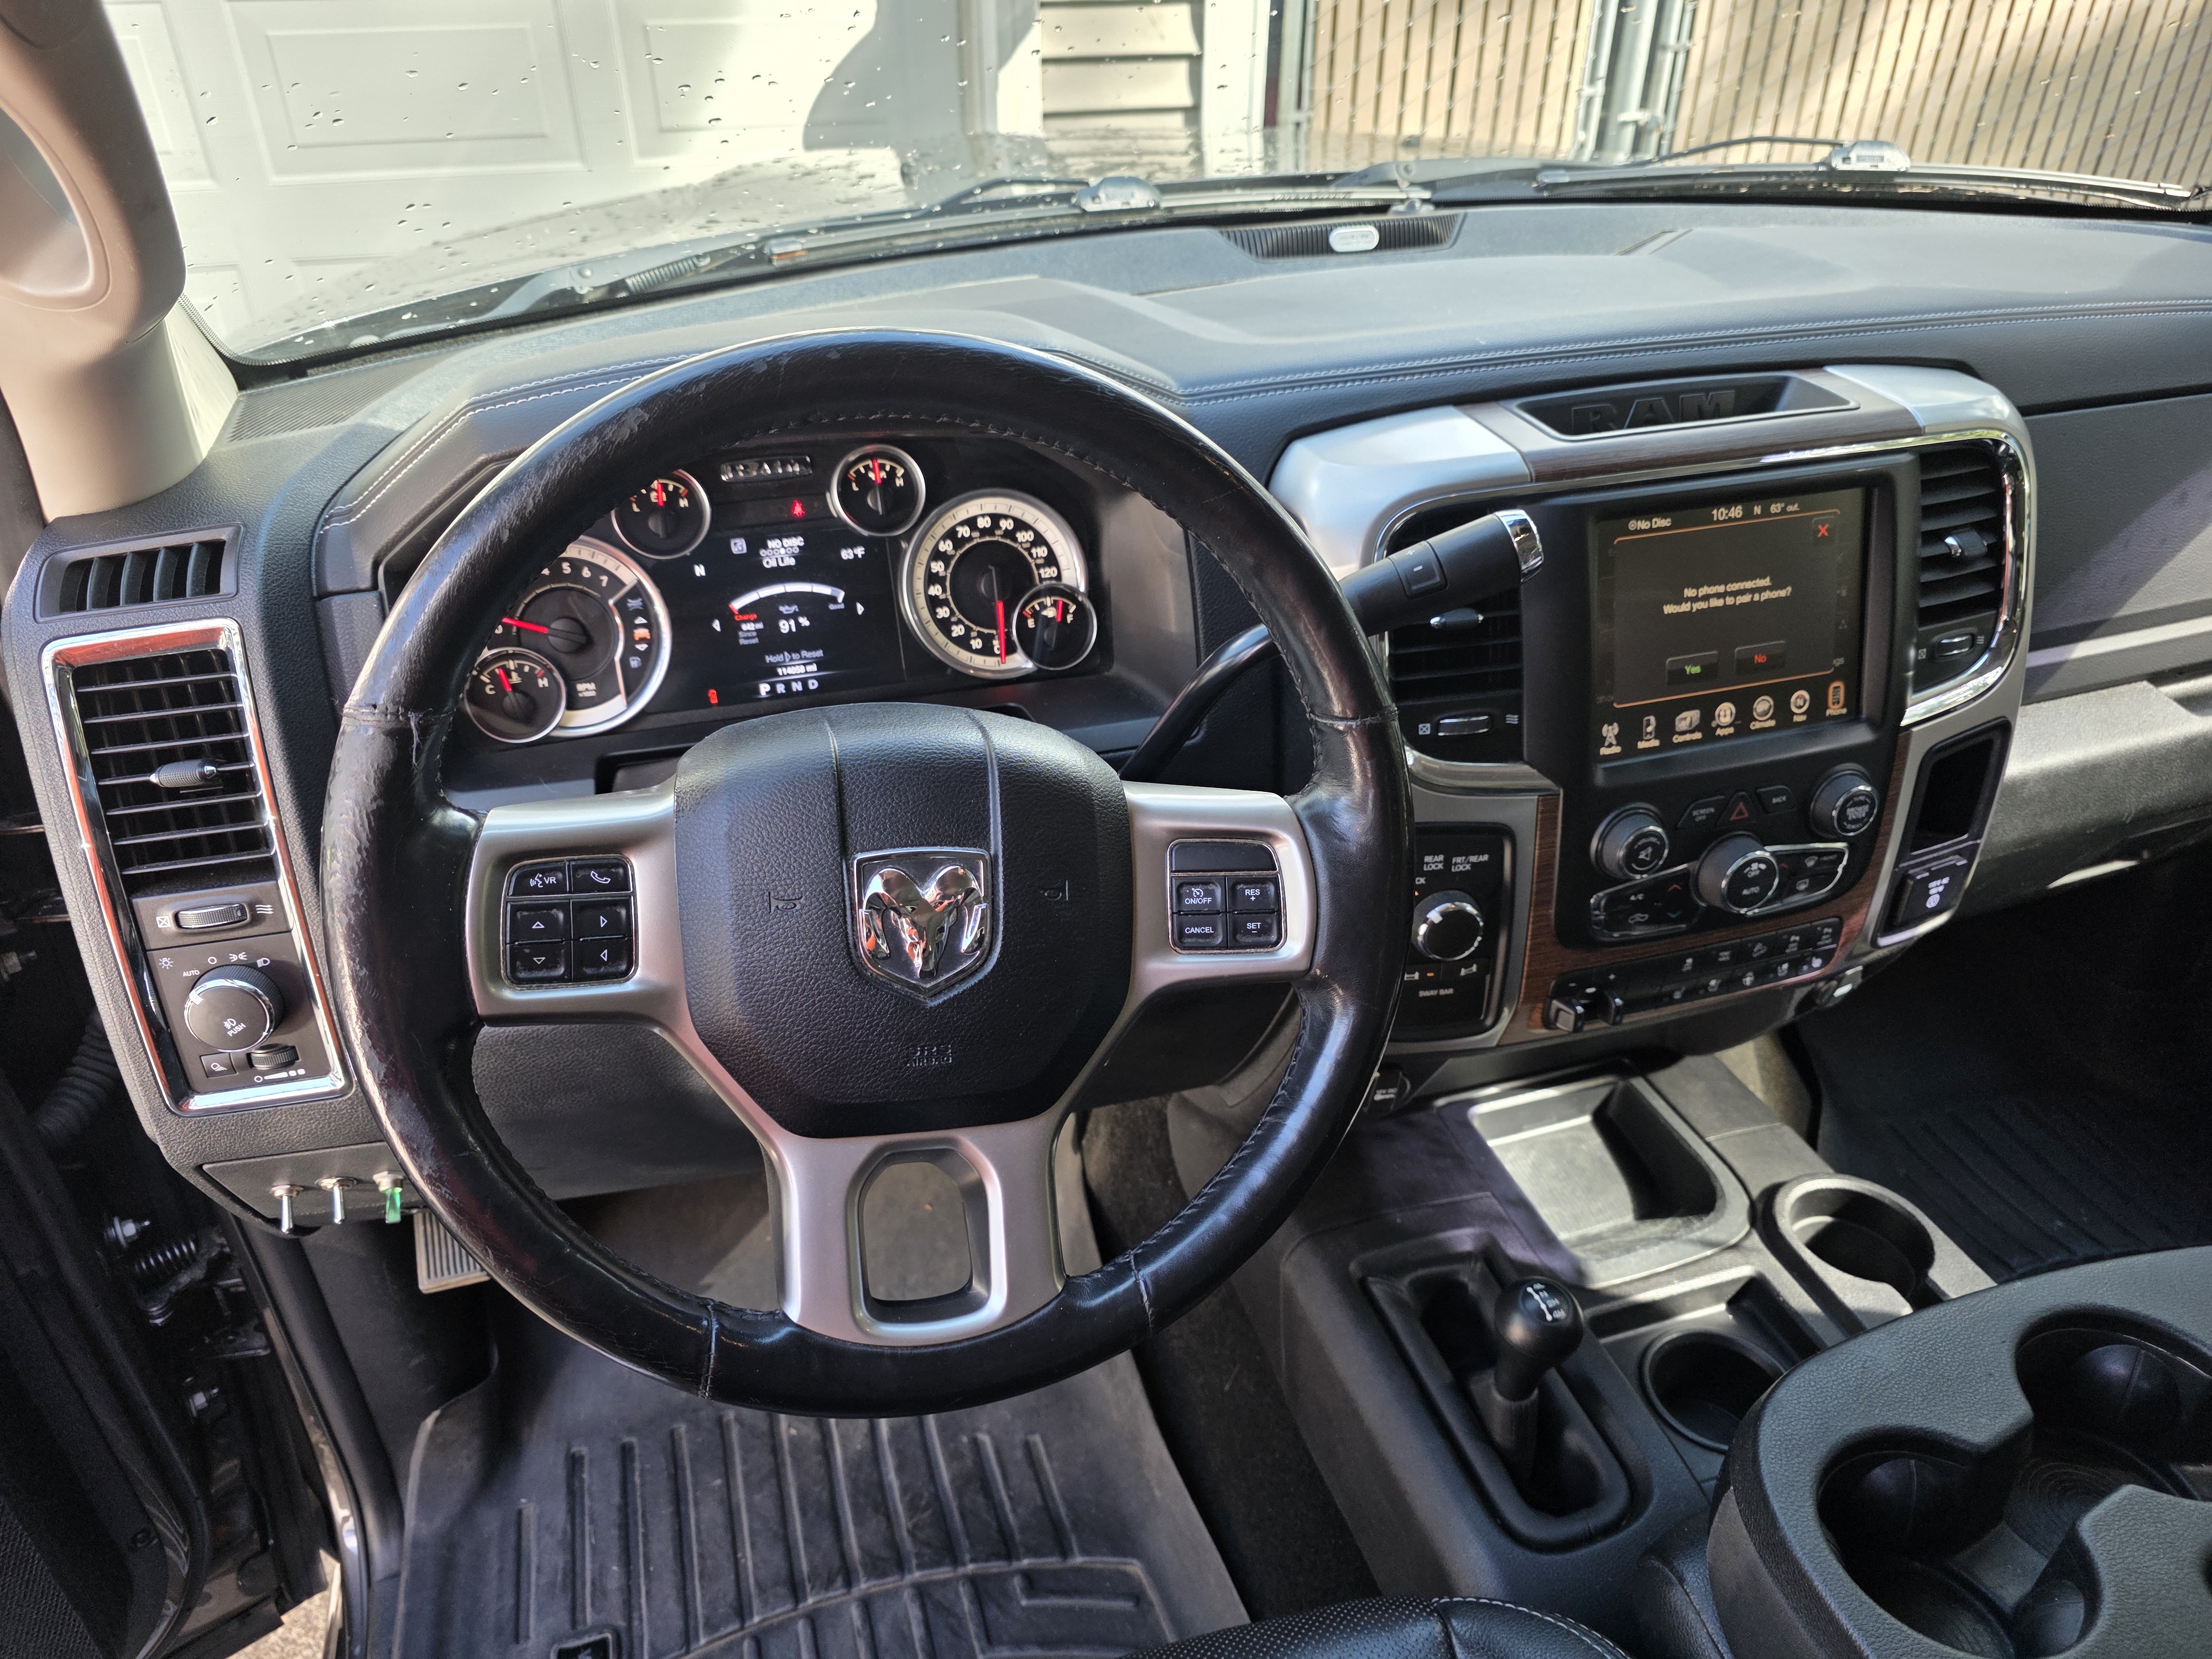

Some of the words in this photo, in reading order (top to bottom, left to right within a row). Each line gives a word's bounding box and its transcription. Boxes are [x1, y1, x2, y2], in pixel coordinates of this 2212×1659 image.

[1571, 389, 1736, 435] RAM
[1711, 505, 1743, 521] 10:46
[1754, 504, 1761, 515] N
[977, 515, 992, 529] 80
[999, 518, 1014, 531] 90
[1637, 520, 1651, 530] No
[1652, 517, 1672, 529] Disc
[955, 525, 971, 538] 70
[1015, 529, 1034, 542] 100
[766, 538, 782, 549] NO
[782, 535, 805, 547] DISC
[938, 539, 953, 552] 60
[1031, 545, 1048, 558] 110
[561, 562, 572, 574] 5
[762, 557, 777, 568] Oil
[778, 556, 796, 567] Life
[930, 560, 945, 573] 50
[581, 566, 592, 578] 6
[693, 564, 706, 577] N
[1039, 566, 1058, 578] 120
[599, 575, 608, 587] 7
[927, 583, 942, 596] 40
[1684, 587, 1697, 598] No
[1698, 583, 1725, 598] phone
[1663, 601, 1691, 615] Would
[1692, 600, 1709, 613] you
[1709, 597, 1725, 608] like
[1725, 595, 1735, 606] to
[1736, 592, 1754, 606] pair
[1753, 593, 1760, 602] a
[1760, 585, 1792, 602] phone?
[734, 613, 758, 621] Change
[935, 607, 950, 619] 30
[1066, 613, 1073, 624] F
[778, 618, 796, 634] 91
[1027, 617, 1035, 628] E
[951, 624, 965, 637] 20
[969, 638, 983, 650] 10
[765, 653, 784, 664] Hold
[791, 652, 801, 660] to
[801, 649, 824, 659] Reset
[1754, 654, 1767, 664] No
[1684, 664, 1702, 675] Yes
[537, 677, 549, 688] H
[758, 683, 771, 696] P
[776, 682, 786, 693] R
[791, 681, 803, 691] N
[807, 679, 819, 690] D
[484, 684, 497, 695] C
[1672, 731, 1703, 744] Controls
[1715, 726, 1735, 737] Apps
[1424, 854, 1444, 863] REAR
[1452, 853, 1490, 865] FRT/REAR
[1423, 862, 1444, 872] LOCK
[1451, 863, 1472, 873] LOCK
[544, 876, 557, 885] VR
[182, 969, 200, 977] AUTO
[1439, 987, 1454, 996] BAR
[227, 1022, 247, 1037] PUSH
